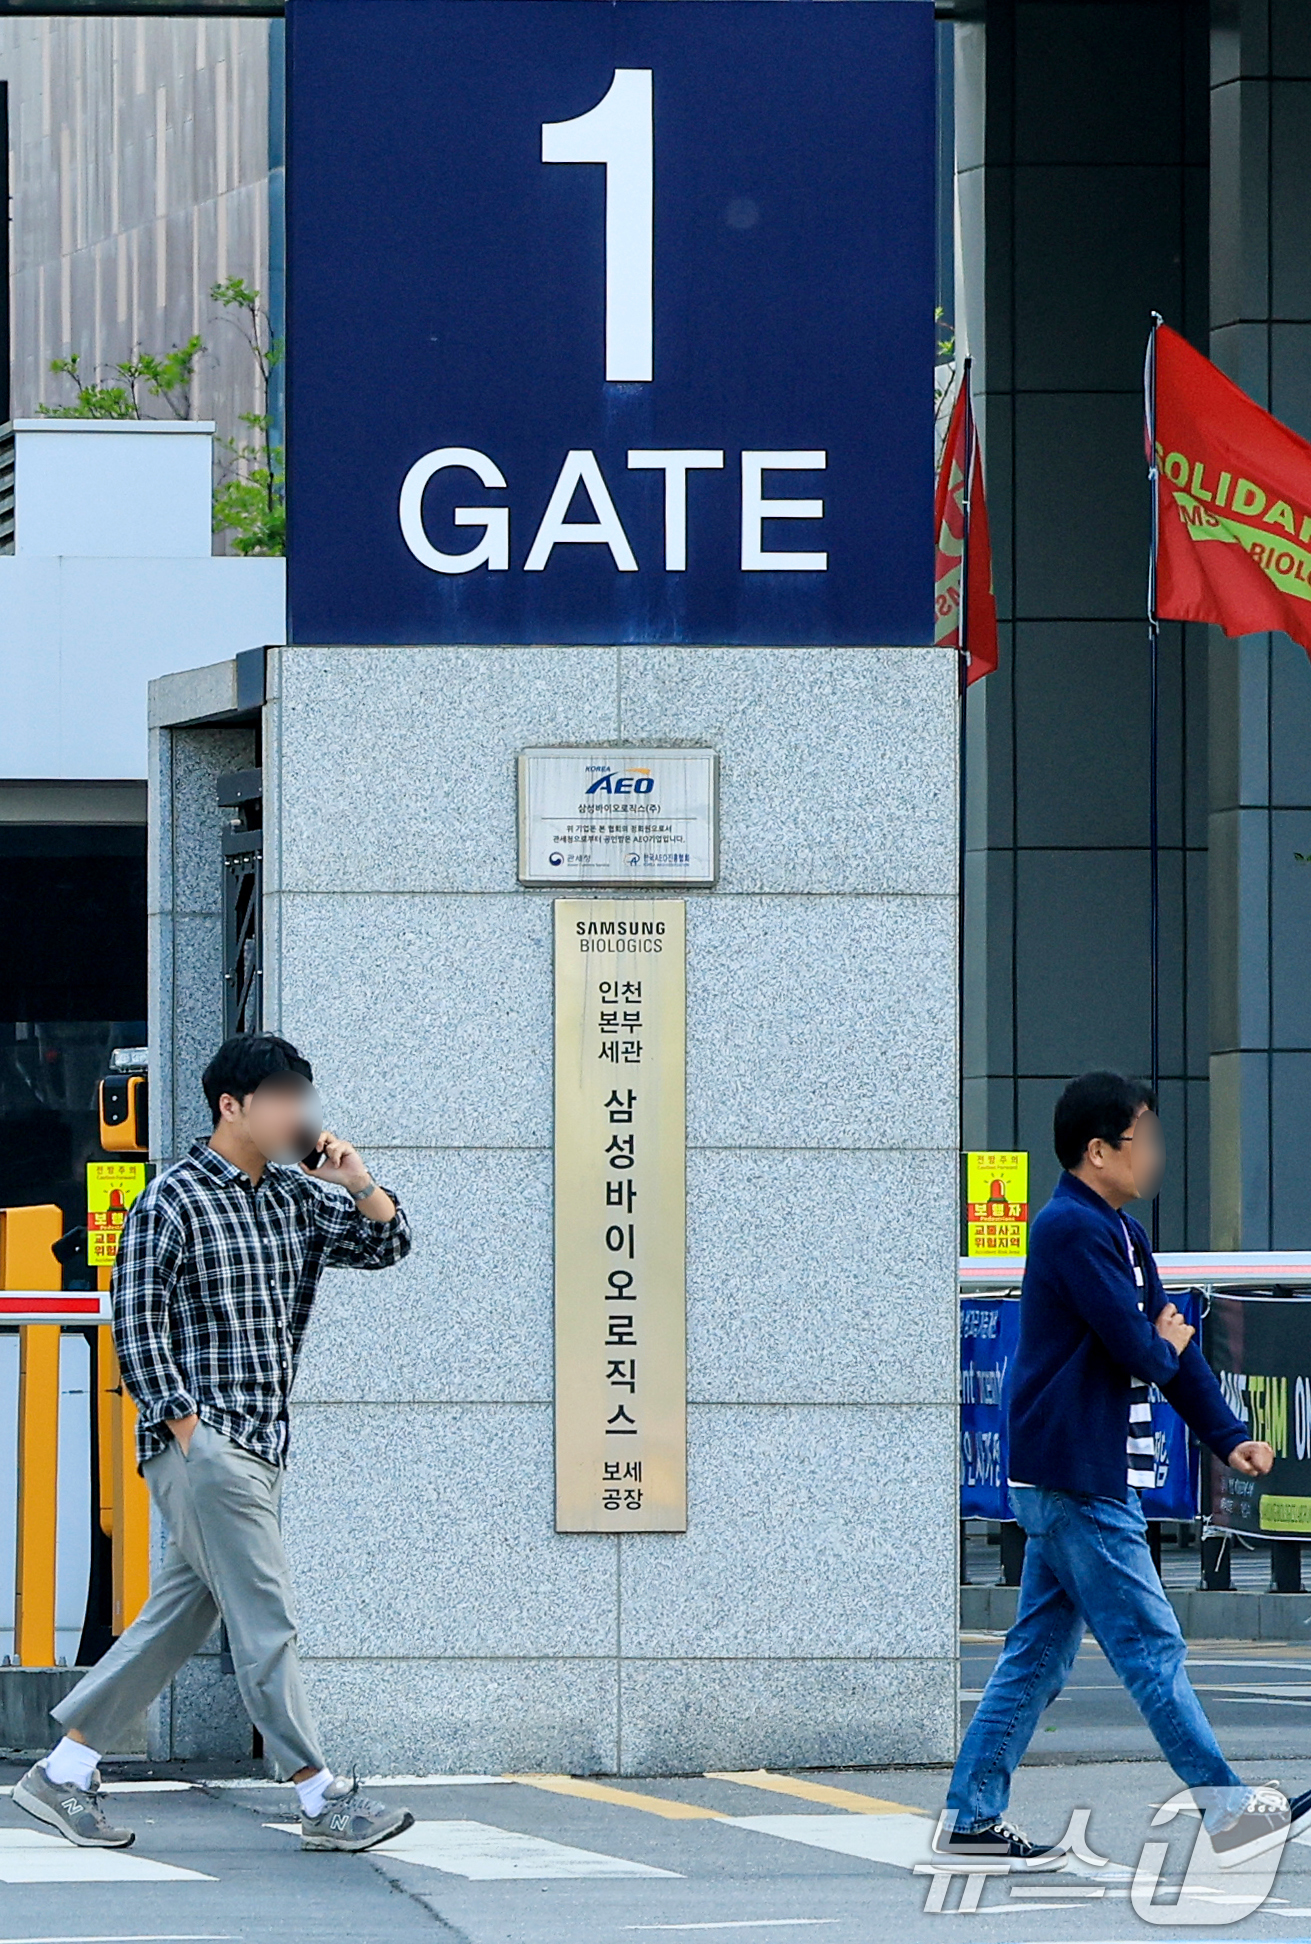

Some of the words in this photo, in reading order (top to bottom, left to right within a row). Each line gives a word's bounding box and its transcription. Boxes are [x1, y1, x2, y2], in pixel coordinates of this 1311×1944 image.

[542, 68, 653, 382] 1
[399, 447, 828, 574] GATE
[1251, 542, 1311, 587] BIOL
[585, 765, 611, 773] KOREA
[584, 771, 655, 795] AEO
[578, 803, 661, 814] 삼성바이오로직스(주)
[567, 853, 591, 863] 관세청
[576, 921, 666, 936] SAMSUNG
[580, 938, 663, 953] BIOLOGICS
[598, 980, 643, 1005] 인천
[598, 1010, 643, 1034] 본부
[598, 1039, 643, 1064] 세관
[603, 1088, 638, 1436] 삼성바이오로직스
[602, 1460, 643, 1483] 보세
[602, 1488, 644, 1511] 공장
